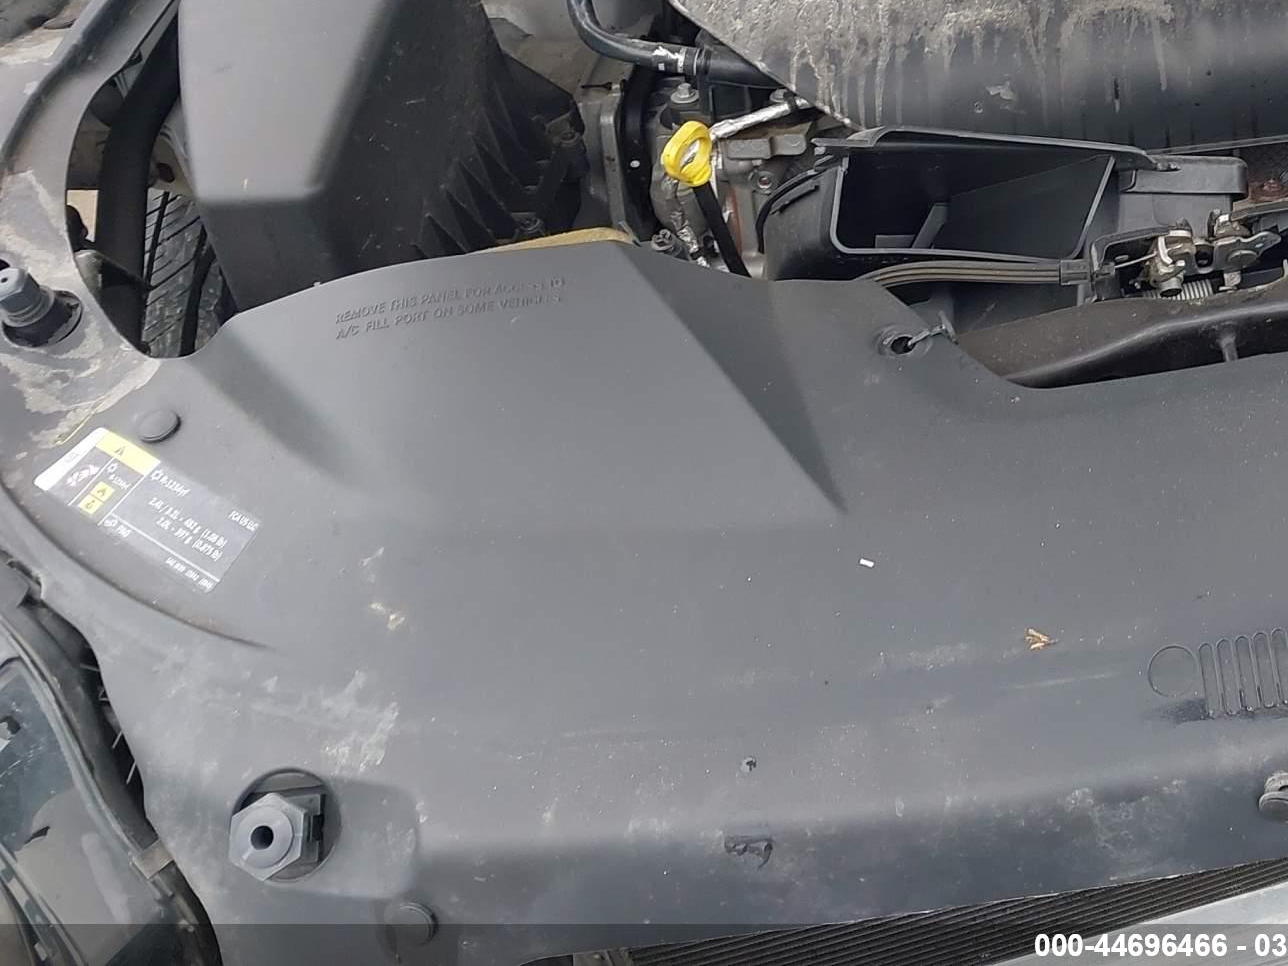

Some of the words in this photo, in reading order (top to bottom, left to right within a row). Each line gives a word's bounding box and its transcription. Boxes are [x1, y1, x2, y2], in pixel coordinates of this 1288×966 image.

[335, 301, 386, 324] REMOVE
[390, 296, 417, 312] THIS
[419, 289, 461, 305] PANEL
[465, 286, 491, 299] FOR
[335, 324, 361, 340] A/C
[365, 317, 391, 333] FILL
[394, 310, 429, 326] PORT
[433, 305, 454, 319] ON
[457, 301, 495, 315] SOME
